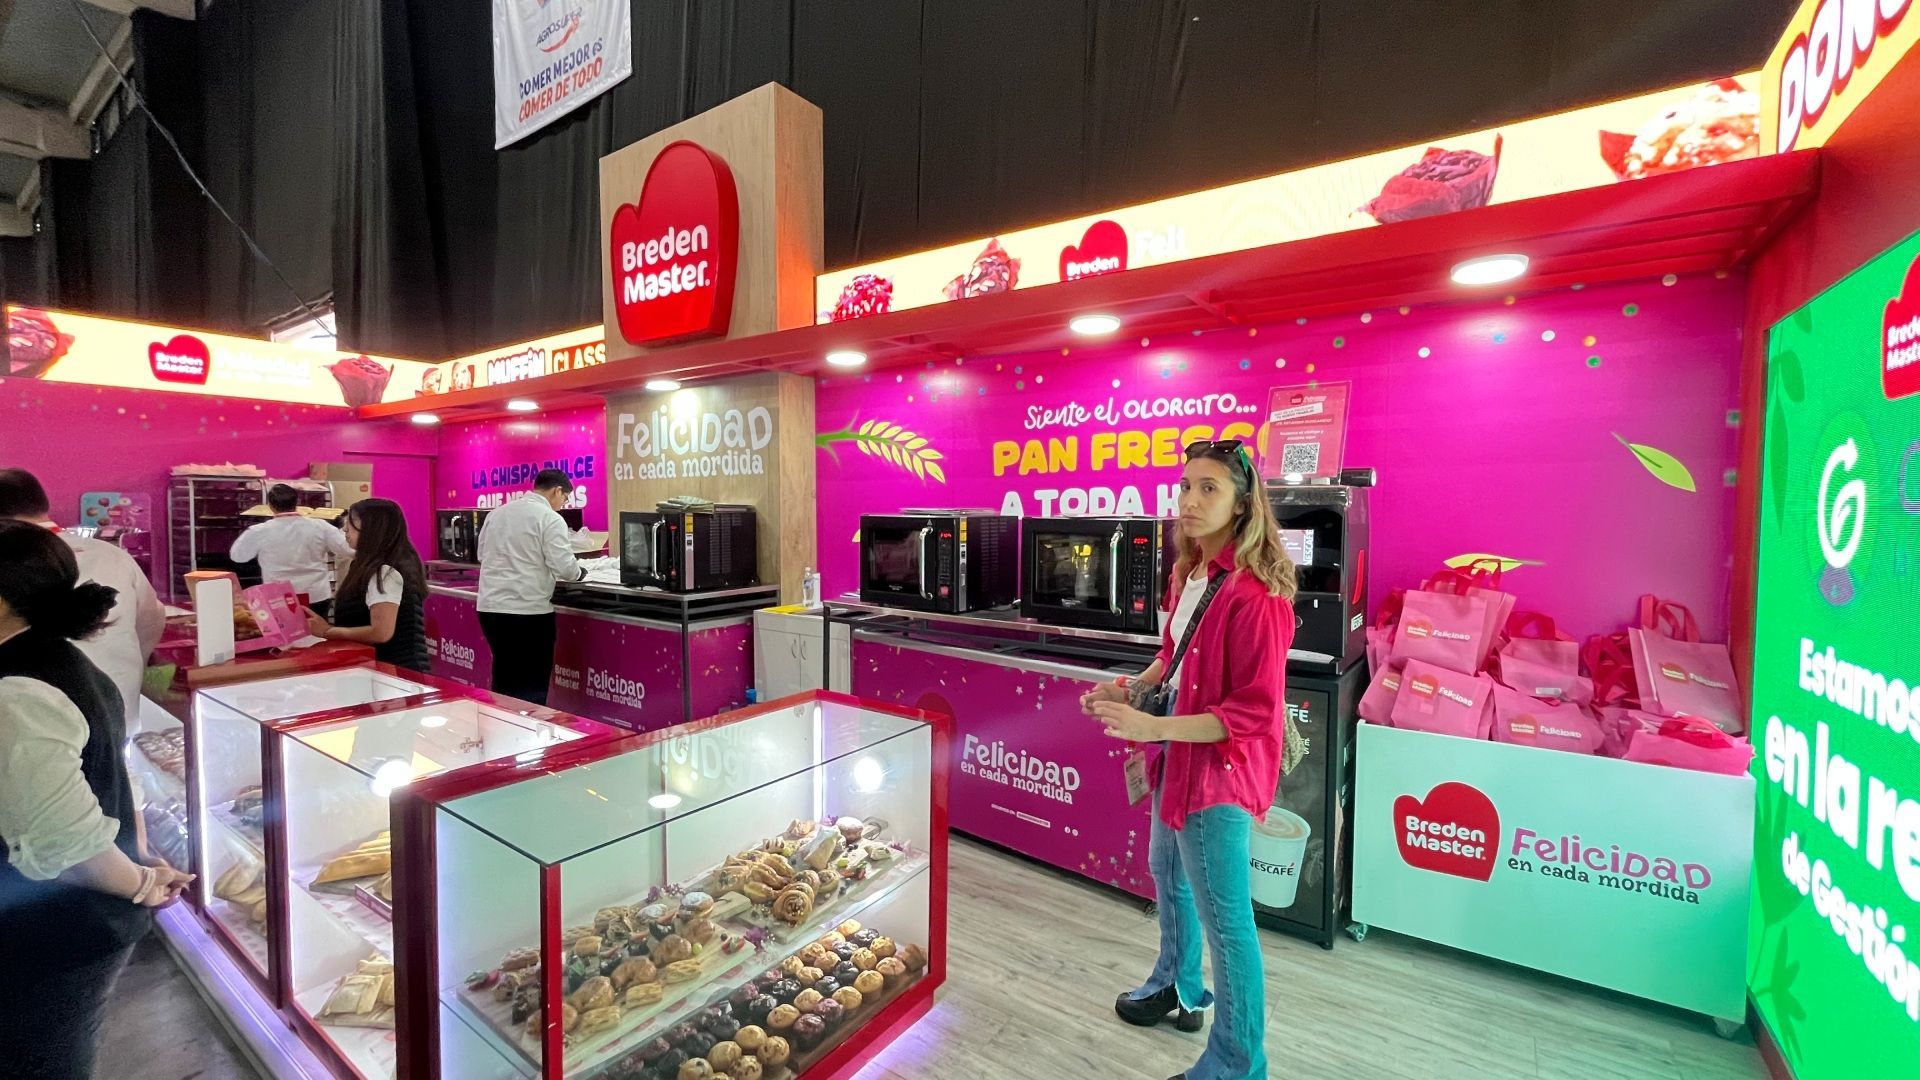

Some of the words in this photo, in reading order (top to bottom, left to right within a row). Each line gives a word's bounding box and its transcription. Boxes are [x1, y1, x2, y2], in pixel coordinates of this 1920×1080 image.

[553, 43, 590, 79] MEJOR
[1777, 0, 1912, 154] DON
[518, 87, 552, 123] COMER
[555, 76, 571, 101] DE
[572, 57, 603, 92] TODO
[622, 224, 708, 272] Breden
[1066, 256, 1120, 277] Breden
[1024, 401, 1091, 430] Siente
[1094, 396, 1120, 426] el
[472, 469, 488, 490] LA
[491, 462, 539, 487] CHISPA
[614, 461, 634, 481] en
[638, 453, 677, 480] cada
[681, 448, 764, 478] mordida
[993, 435, 1078, 477] PAN
[999, 490, 1025, 518] A
[1033, 484, 1145, 518] TODA
[1799, 637, 1920, 744] Estamos
[960, 760, 976, 775] en
[979, 767, 1009, 785] cada
[1012, 776, 1073, 805] mordida
[1764, 715, 1809, 808] en
[1813, 720, 1860, 850] la
[1405, 815, 1486, 843] Breden
[1507, 857, 1533, 874] en
[1540, 865, 1590, 884] cada
[1598, 871, 1700, 905] mordida
[1782, 831, 1810, 896] de
[1811, 859, 1920, 1022] Gestión
